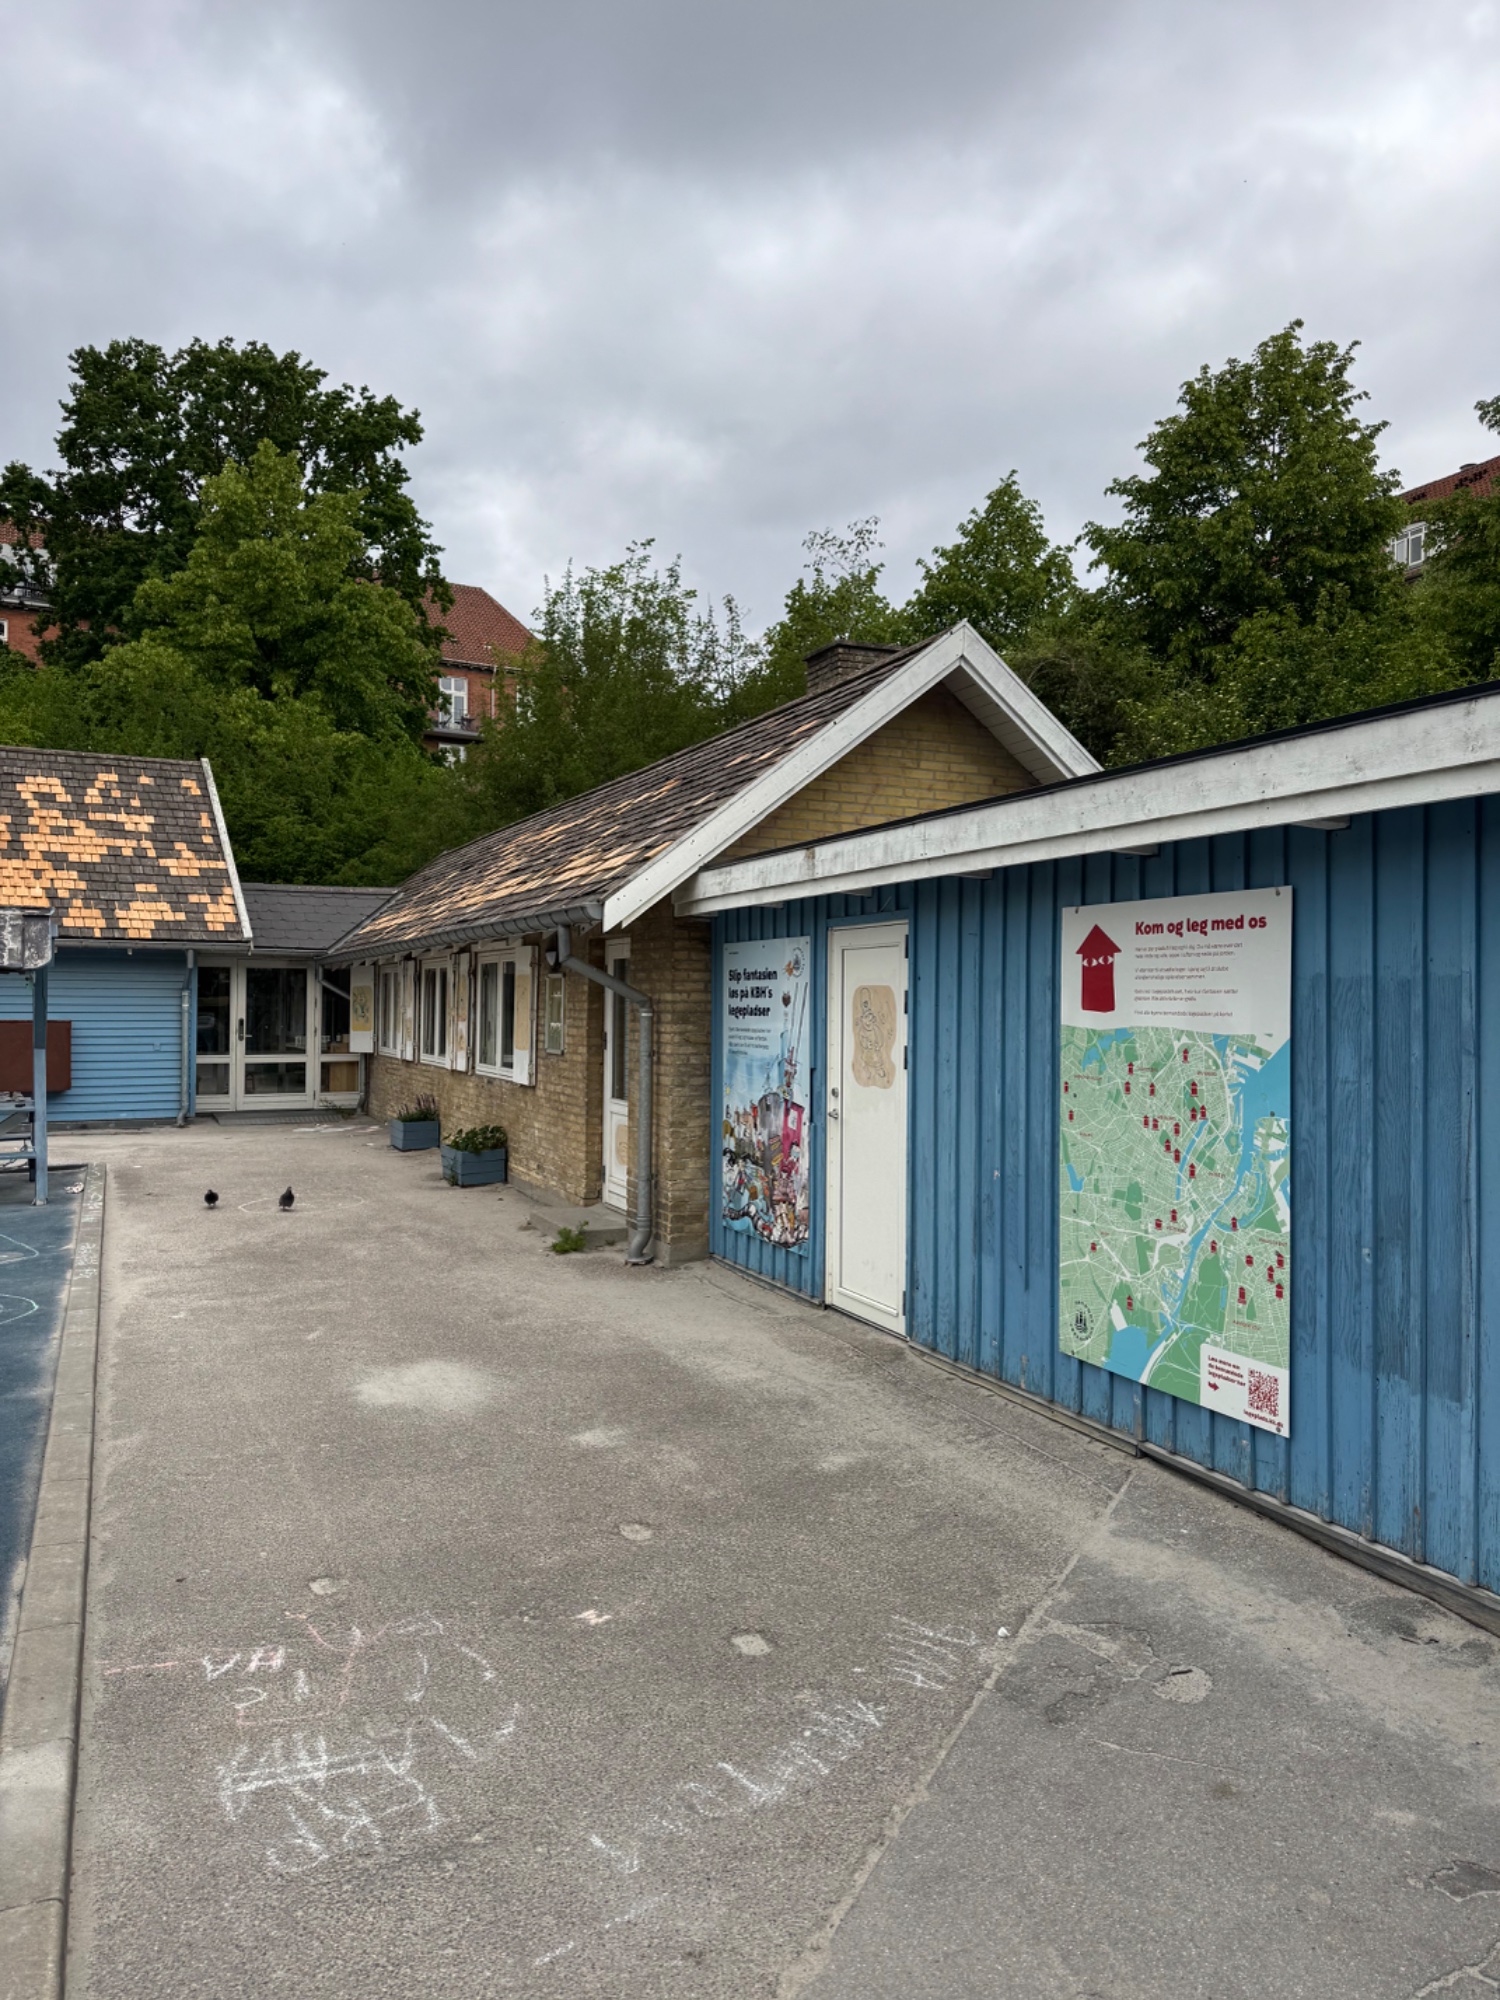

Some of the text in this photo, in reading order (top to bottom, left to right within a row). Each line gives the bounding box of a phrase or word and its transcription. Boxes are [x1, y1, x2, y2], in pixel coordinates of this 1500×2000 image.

[1135, 914, 1267, 938] Kom og leg med os
[728, 967, 778, 984] Slip fantasien
[740, 985, 749, 1002] på
[728, 1004, 771, 1019] legepladser
